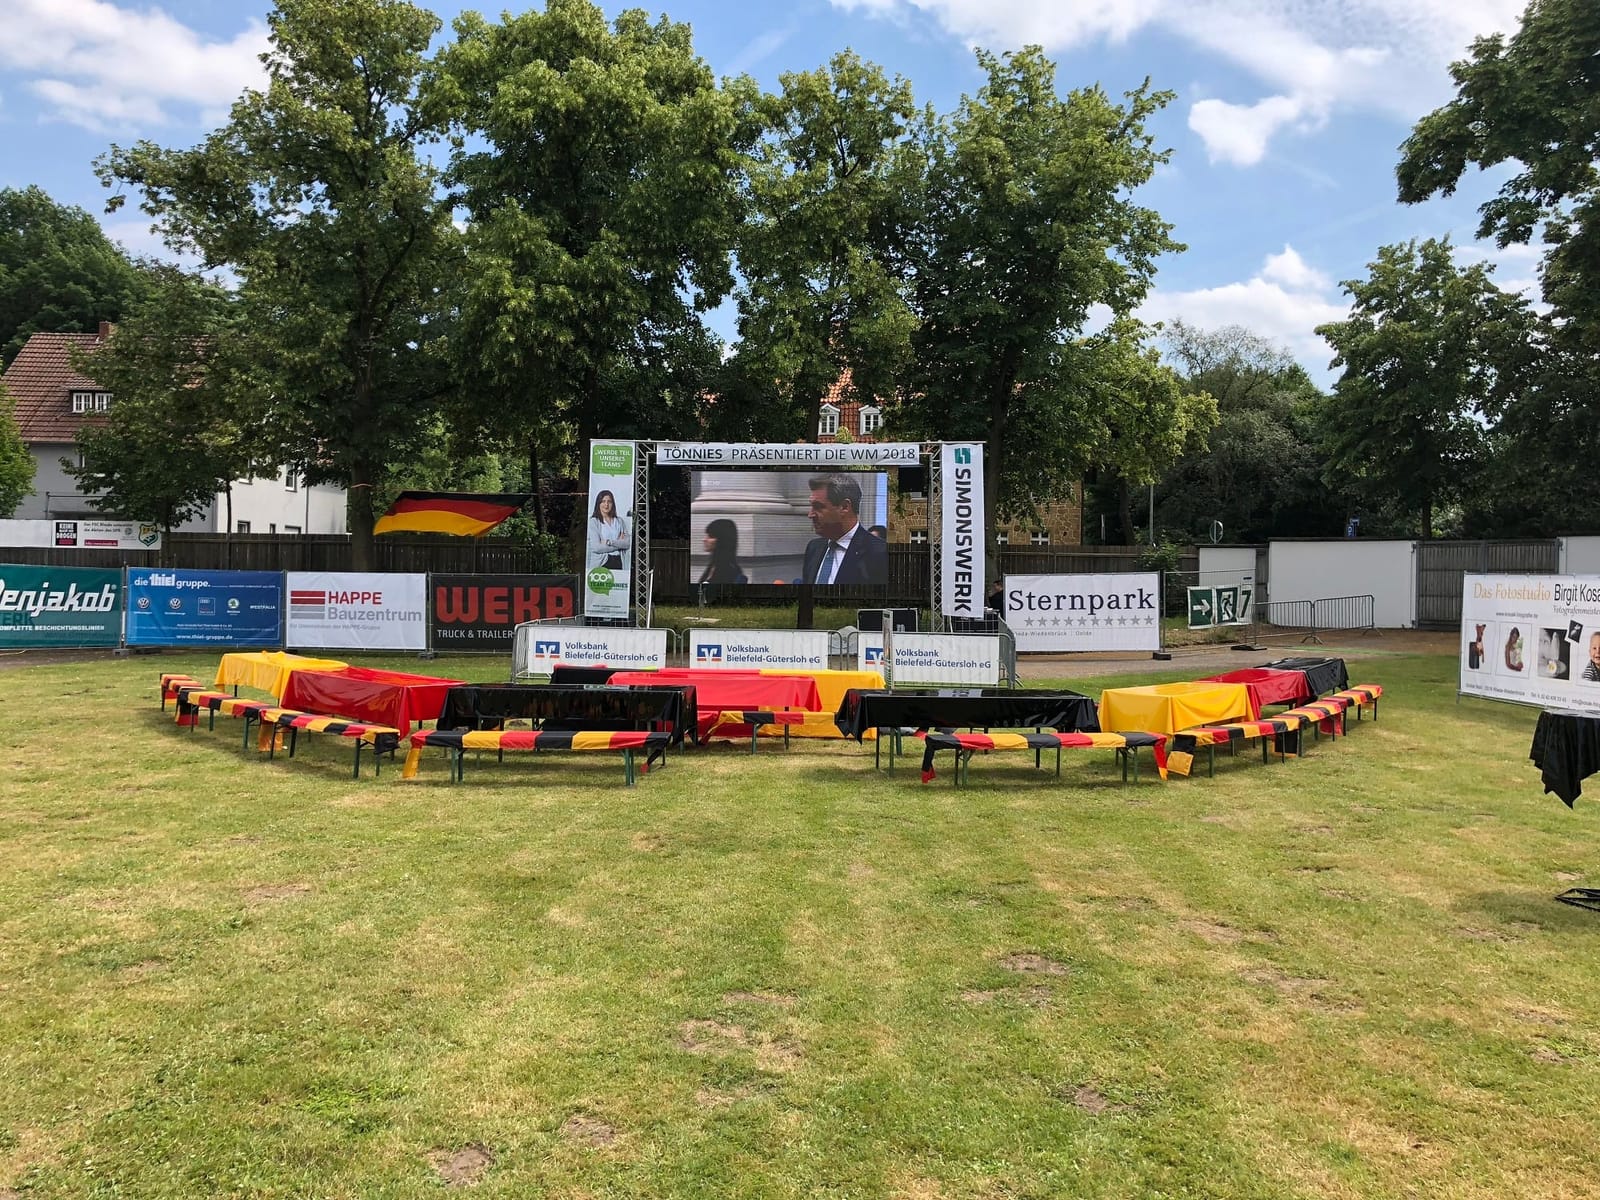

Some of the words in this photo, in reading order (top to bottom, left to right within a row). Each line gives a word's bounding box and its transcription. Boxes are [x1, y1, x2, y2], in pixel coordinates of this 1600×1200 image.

[663, 447, 723, 459] TÖNNIES
[731, 447, 821, 460] PRÄSENTIERT
[825, 449, 847, 460] DIE
[850, 448, 878, 460] WM
[882, 448, 916, 460] 2018
[954, 467, 973, 612] SIMONSWERK
[134, 577, 148, 586] die
[149, 573, 176, 587] thiel
[176, 580, 211, 589] gruppe.
[0, 579, 115, 617] enjakob
[328, 591, 382, 605] HAPPE
[1473, 583, 1493, 599] Das
[1495, 582, 1551, 601] Fotostudio
[1554, 584, 1578, 606] Birgit
[1008, 588, 1156, 616] Sternpark
[1241, 590, 1252, 618] 7
[328, 606, 422, 621] Bauzentrum
[437, 629, 466, 639] TRUCK
[467, 630, 474, 639] &
[477, 630, 513, 639] TRAILER
[565, 642, 608, 650] Volksbank
[726, 645, 770, 653] Volksbank
[895, 648, 939, 657] Volksbank
[565, 651, 645, 661] Bielefeld-Gütersloh
[726, 654, 807, 663] Bielefeld-Gütersloh
[809, 656, 821, 664] eG
[895, 658, 977, 668] Bielefeld-Gütersloh
